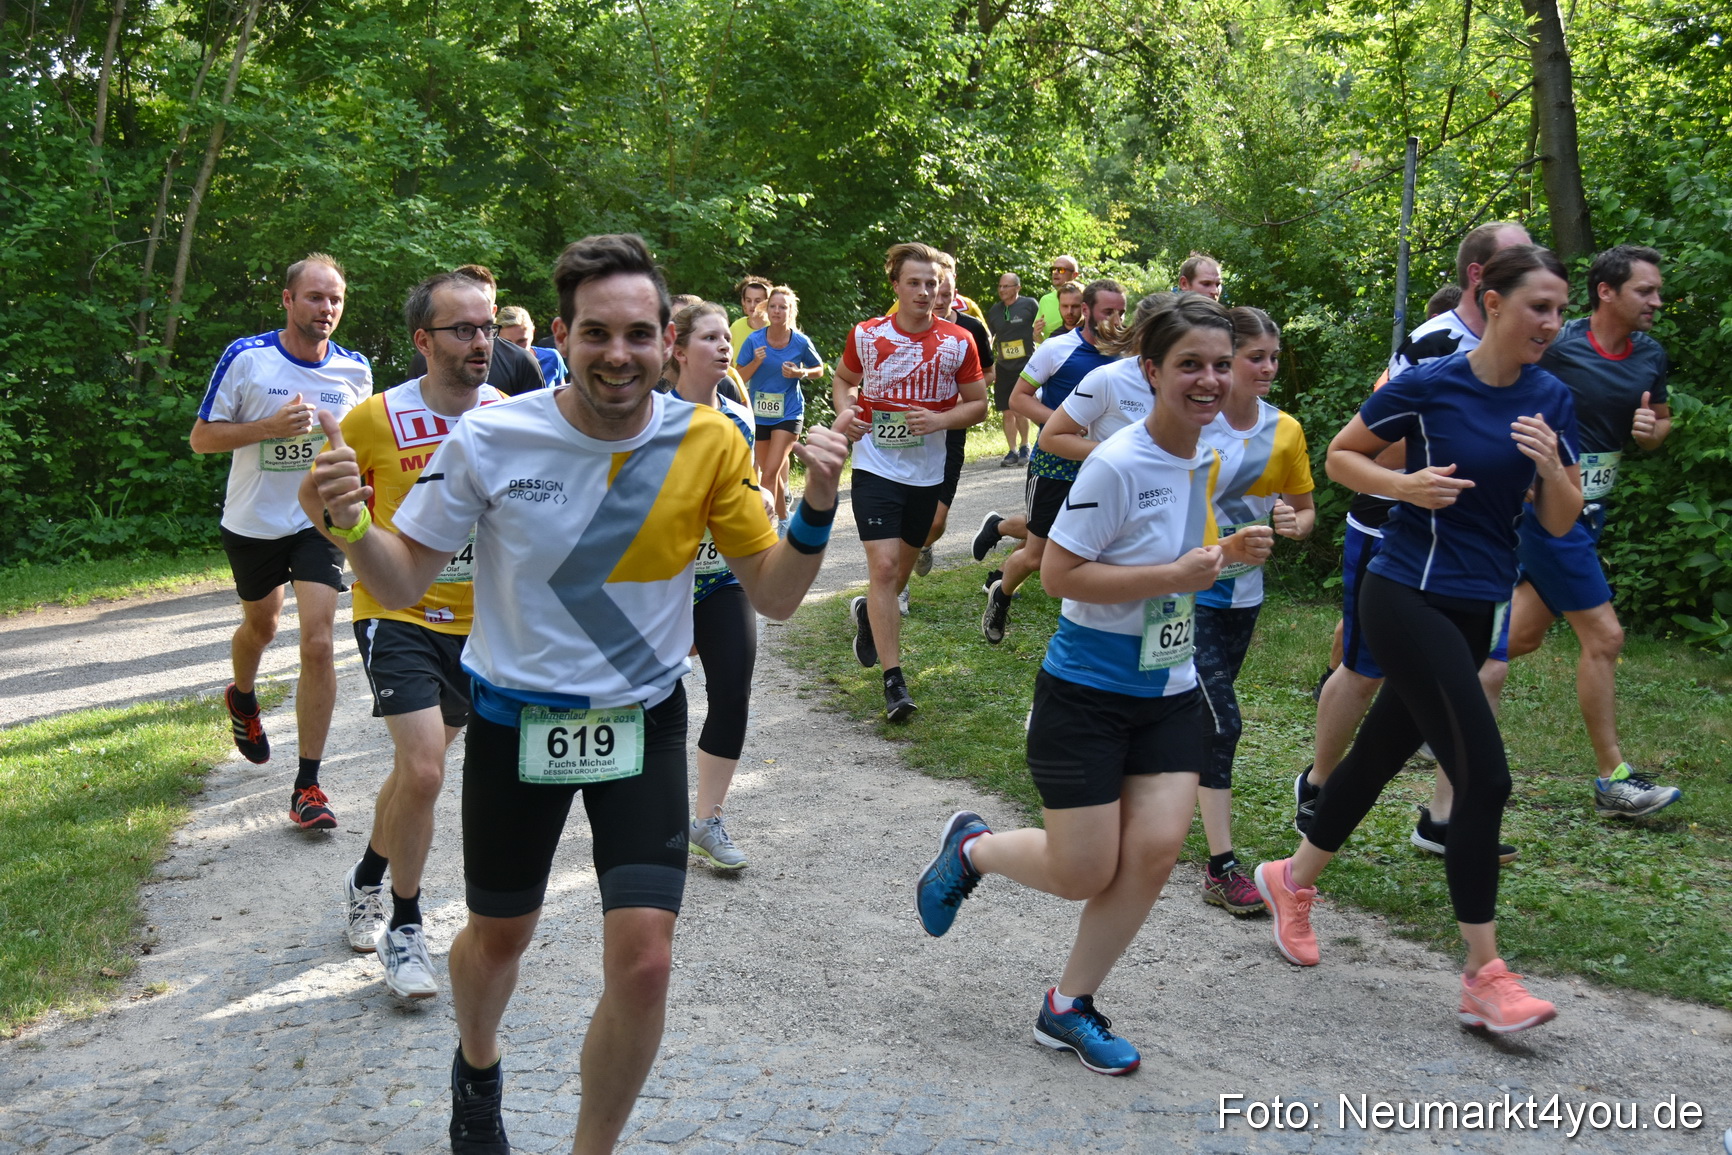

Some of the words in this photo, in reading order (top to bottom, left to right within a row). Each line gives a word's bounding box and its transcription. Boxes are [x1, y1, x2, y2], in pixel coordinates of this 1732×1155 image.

[1006, 347, 1020, 355] 428
[268, 388, 289, 396] JAKO
[757, 400, 780, 411] 1086
[1120, 399, 1144, 408] DESSIGN
[274, 442, 313, 461] 935
[509, 478, 564, 493] DESSIGN
[508, 488, 551, 503] GROUP
[1138, 487, 1173, 501] DESSIGN
[1138, 497, 1169, 510] GROUP
[1159, 618, 1191, 649] 622
[613, 715, 636, 723] 2019
[547, 724, 615, 759] 619
[548, 760, 577, 768] Fuchs
[579, 758, 616, 767] Michael
[543, 768, 573, 776] DESSIGN
